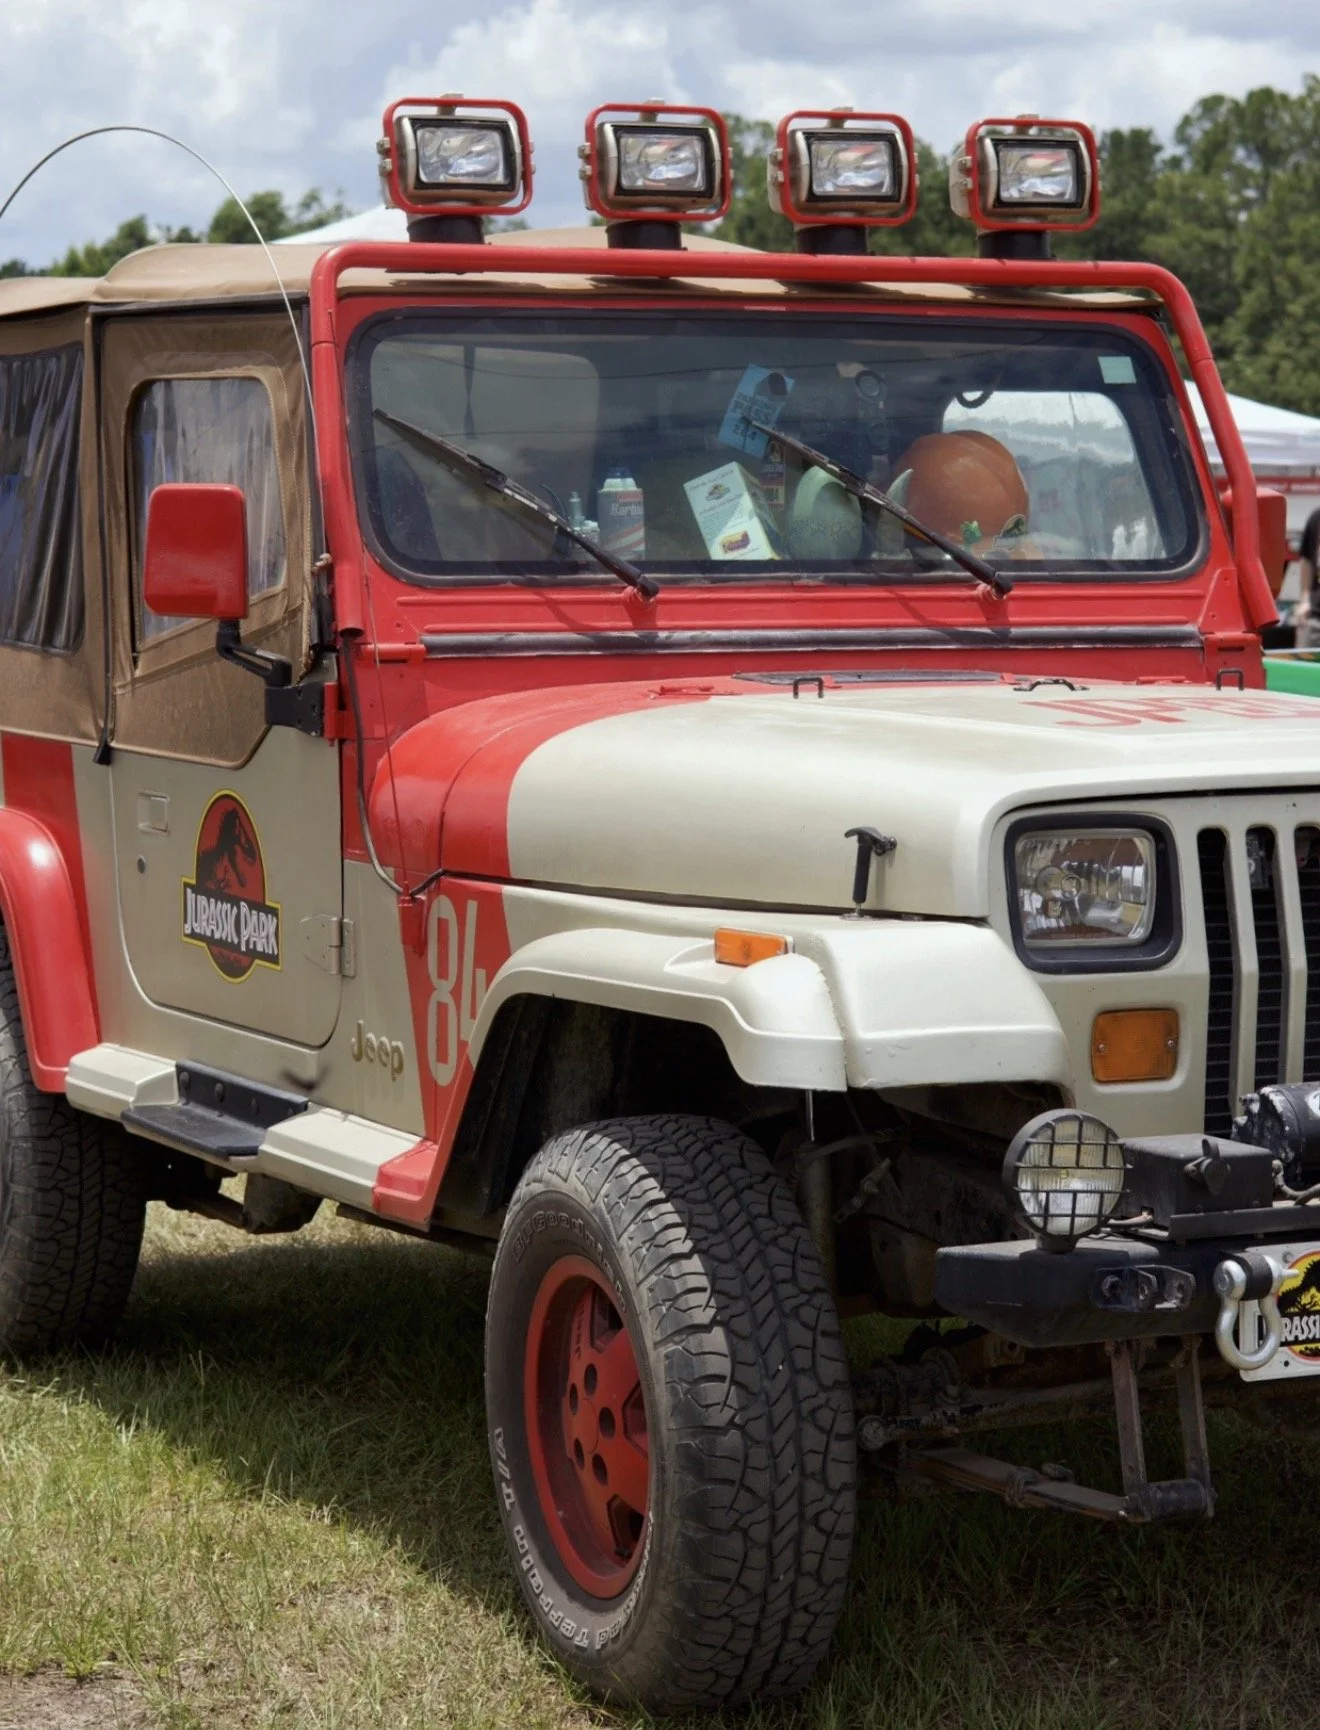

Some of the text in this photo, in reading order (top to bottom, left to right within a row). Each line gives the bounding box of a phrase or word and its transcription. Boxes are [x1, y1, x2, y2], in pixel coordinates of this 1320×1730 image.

[184, 887, 278, 956] JURASSIC PARK
[427, 895, 487, 1087] 84
[351, 1019, 404, 1082] Jeep
[494, 1427, 516, 1511] T/A
[513, 1524, 590, 1648] Terrain
